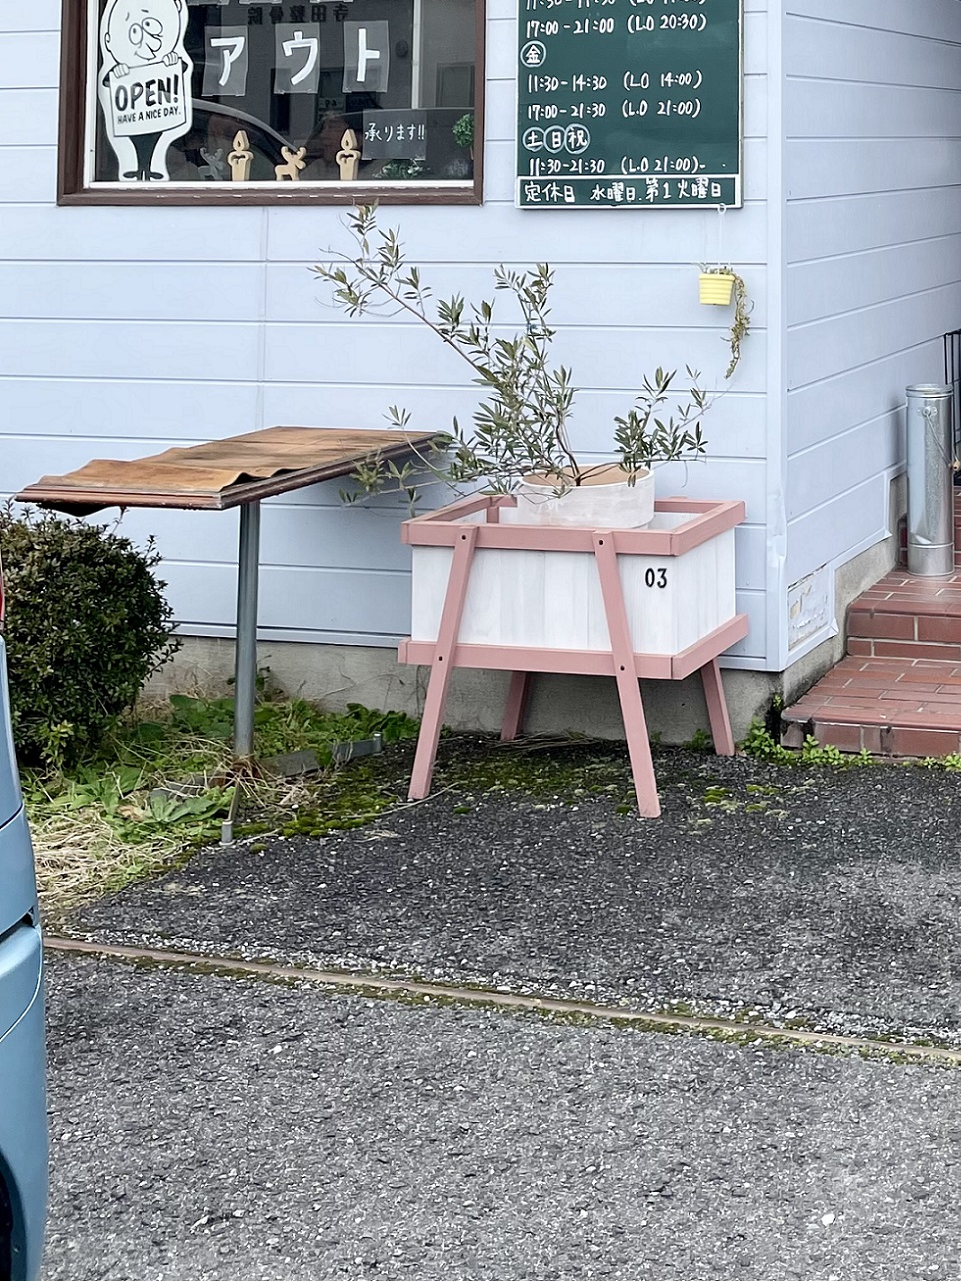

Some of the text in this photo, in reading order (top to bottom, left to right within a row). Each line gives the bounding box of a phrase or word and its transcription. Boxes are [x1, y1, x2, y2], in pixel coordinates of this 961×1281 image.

[211, 28, 381, 87] アウト
[521, 40, 546, 67] 金
[115, 74, 179, 111] OPEN!
[118, 113, 136, 124] HAVE
[138, 111, 144, 121] A
[145, 108, 161, 119] NICE
[524, 181, 575, 203] 定休日
[645, 567, 667, 589] 03
